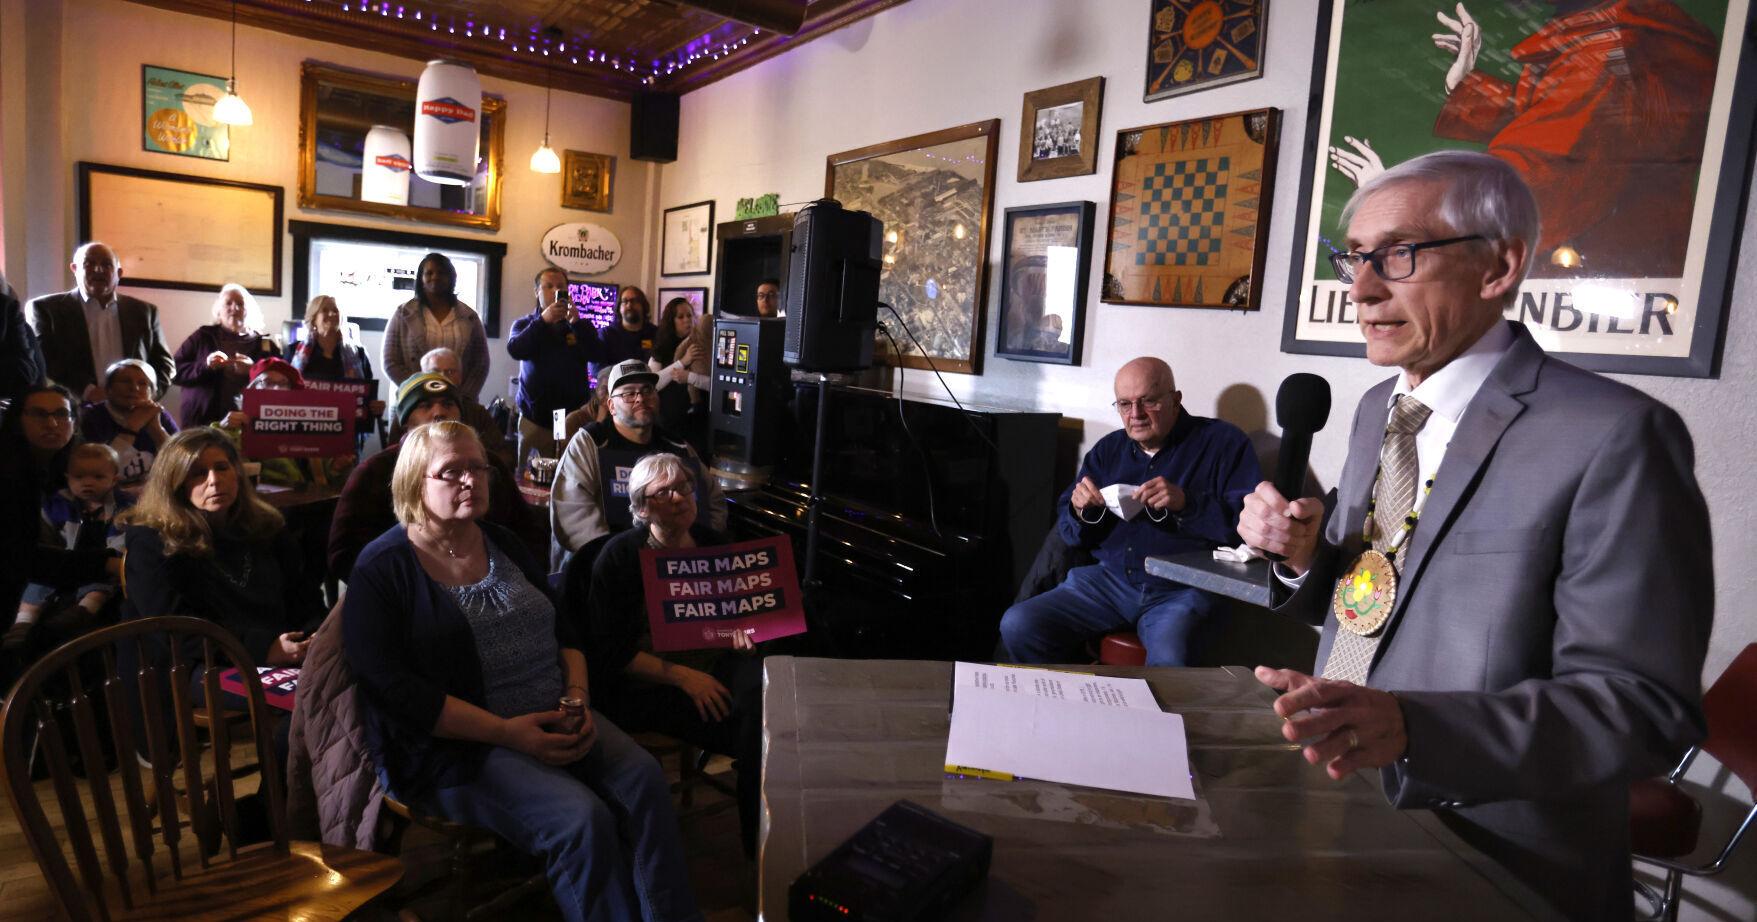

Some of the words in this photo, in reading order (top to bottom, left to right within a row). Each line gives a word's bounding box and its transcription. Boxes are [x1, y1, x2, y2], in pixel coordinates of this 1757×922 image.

[549, 240, 615, 262] Krombacher
[333, 383, 365, 393] MAPS
[264, 408, 306, 418] DOING
[311, 409, 335, 418] THE
[254, 420, 298, 431] RIGHT
[301, 421, 342, 432] THING
[666, 560, 709, 575] FAIR
[714, 551, 769, 572] MAPS
[669, 582, 712, 597] FAIR
[717, 572, 772, 594] MAPS
[673, 603, 717, 618] FAIR
[721, 593, 777, 616] MAPS
